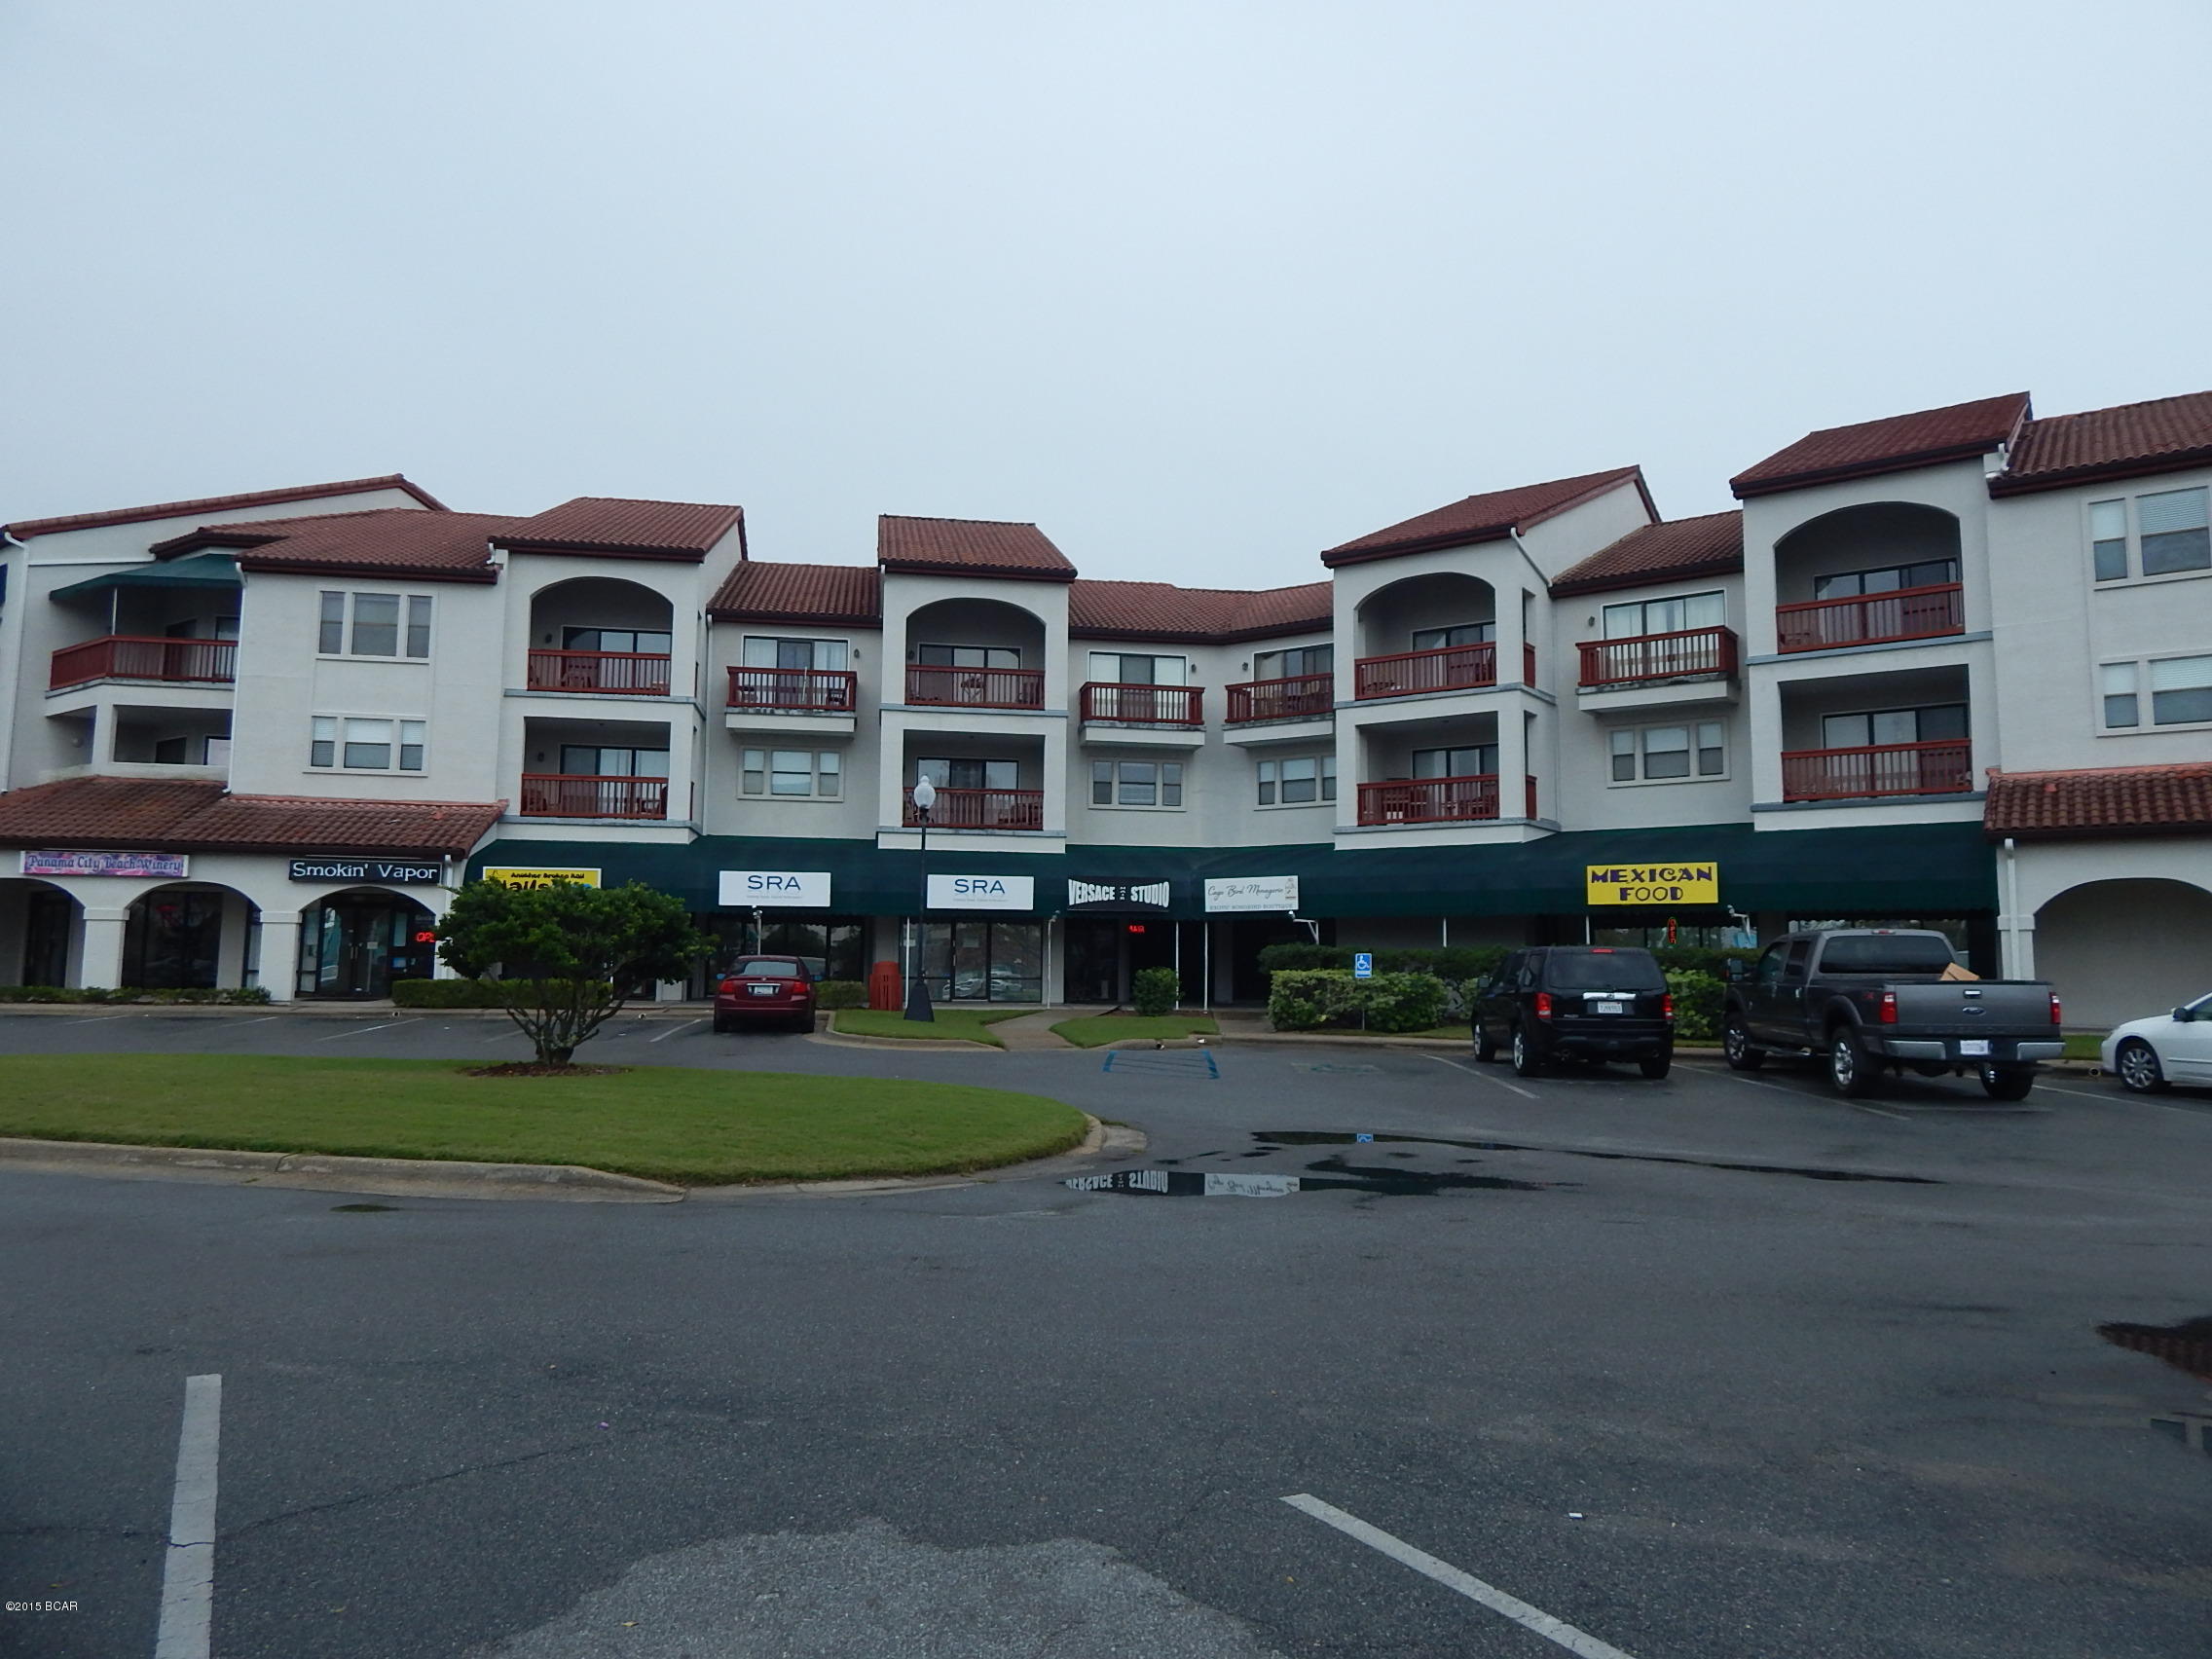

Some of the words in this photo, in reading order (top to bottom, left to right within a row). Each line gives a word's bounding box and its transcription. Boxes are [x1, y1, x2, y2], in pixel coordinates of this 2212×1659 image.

[28, 855, 74, 867] Panama
[78, 856, 100, 872] City
[104, 856, 135, 869] Beach
[138, 858, 181, 873] Winery
[293, 862, 369, 877] Smokin'
[378, 864, 438, 882] Vapor
[748, 874, 801, 891] SRA
[1591, 866, 1713, 883] MEXICAN
[501, 879, 550, 893] ails
[954, 878, 1006, 894] SRA
[1068, 878, 1116, 905] VERSACE
[1130, 881, 1170, 907] STUDIO
[1619, 887, 1683, 902] FOOD
